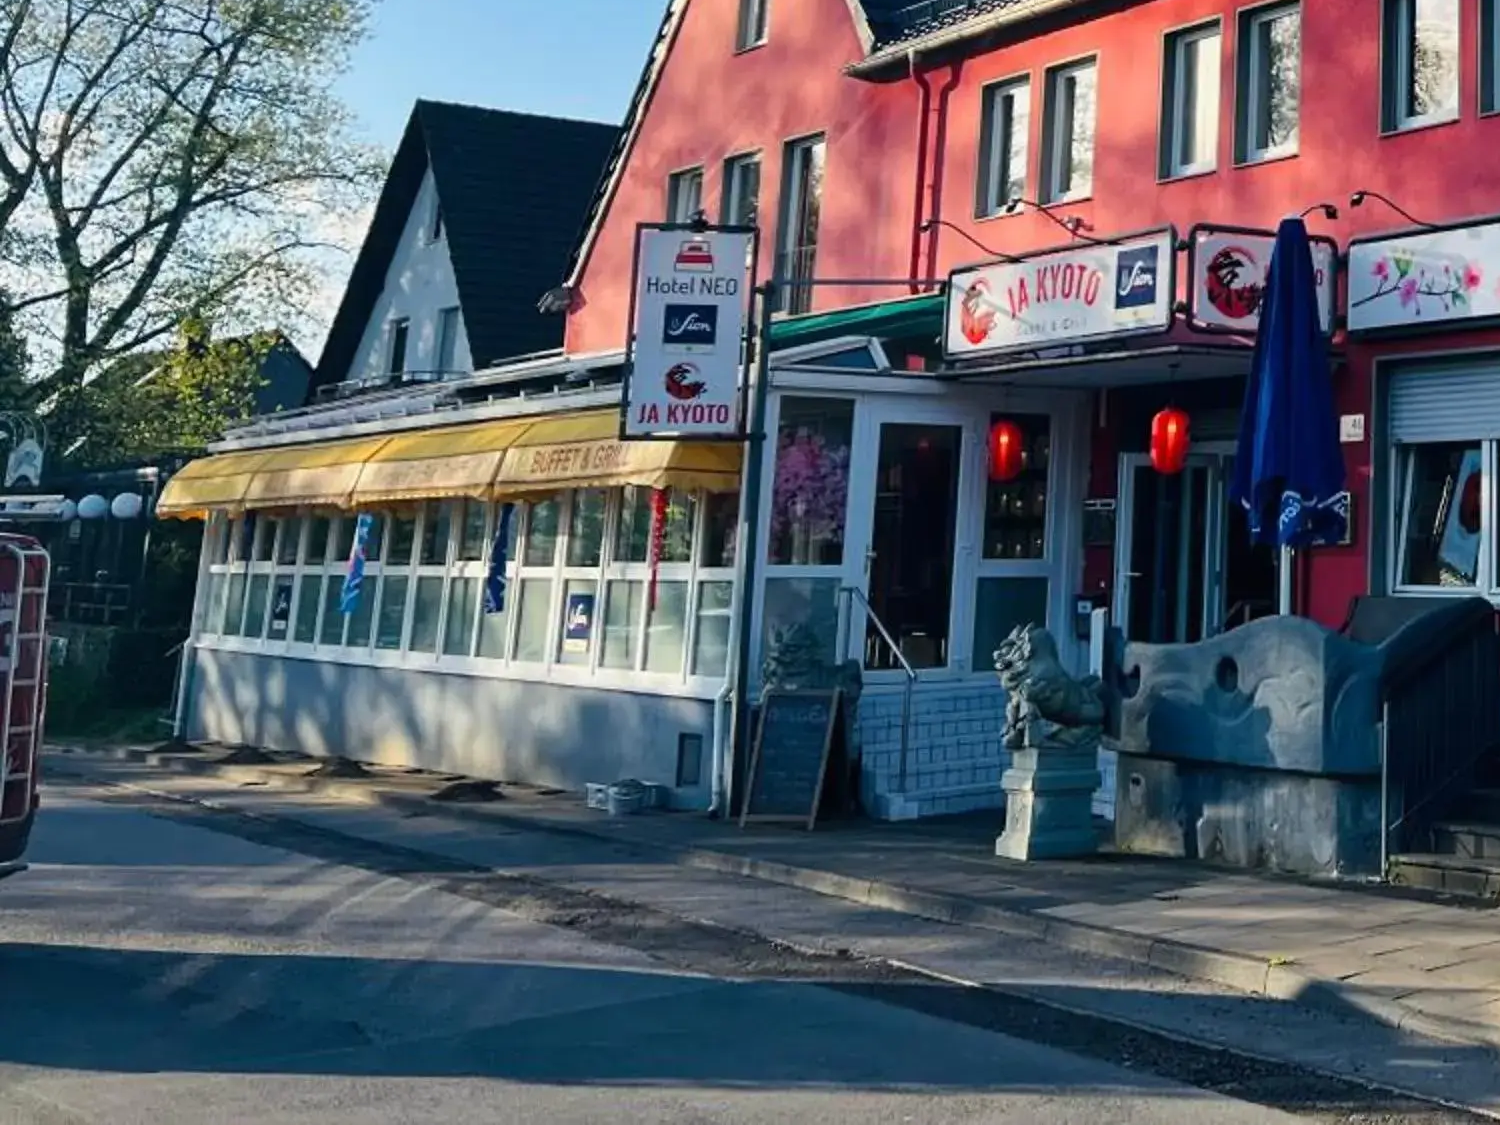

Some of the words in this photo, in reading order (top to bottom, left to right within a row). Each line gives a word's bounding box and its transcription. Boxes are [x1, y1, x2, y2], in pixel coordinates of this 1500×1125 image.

[646, 276, 695, 296] Hotel
[699, 276, 739, 296] NEO
[1008, 276, 1030, 319] JA
[1036, 262, 1102, 306] KYOTO
[637, 403, 660, 425] JA
[667, 403, 730, 425] KYOTO
